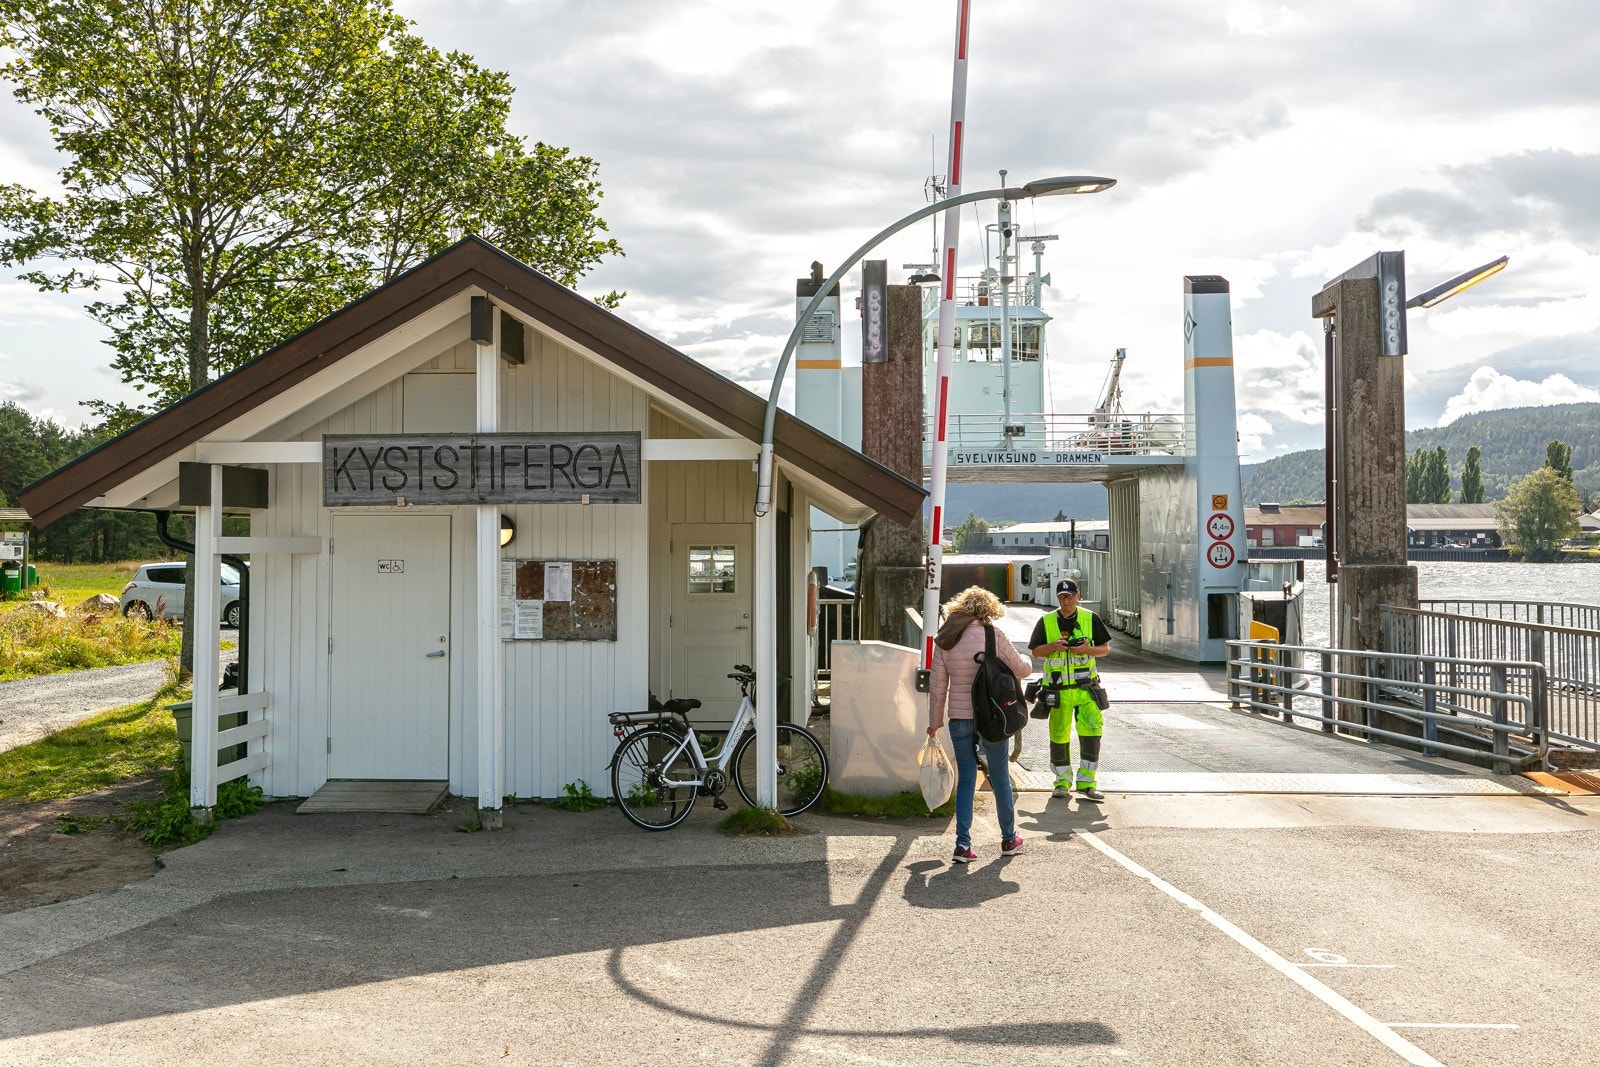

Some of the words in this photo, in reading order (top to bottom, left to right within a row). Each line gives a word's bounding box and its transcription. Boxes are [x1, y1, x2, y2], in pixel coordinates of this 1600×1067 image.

[332, 443, 632, 493] KYSTSTIFERGA
[956, 453, 1037, 464] SVELVIKSUND
[1056, 453, 1101, 463] DRAMMEN
